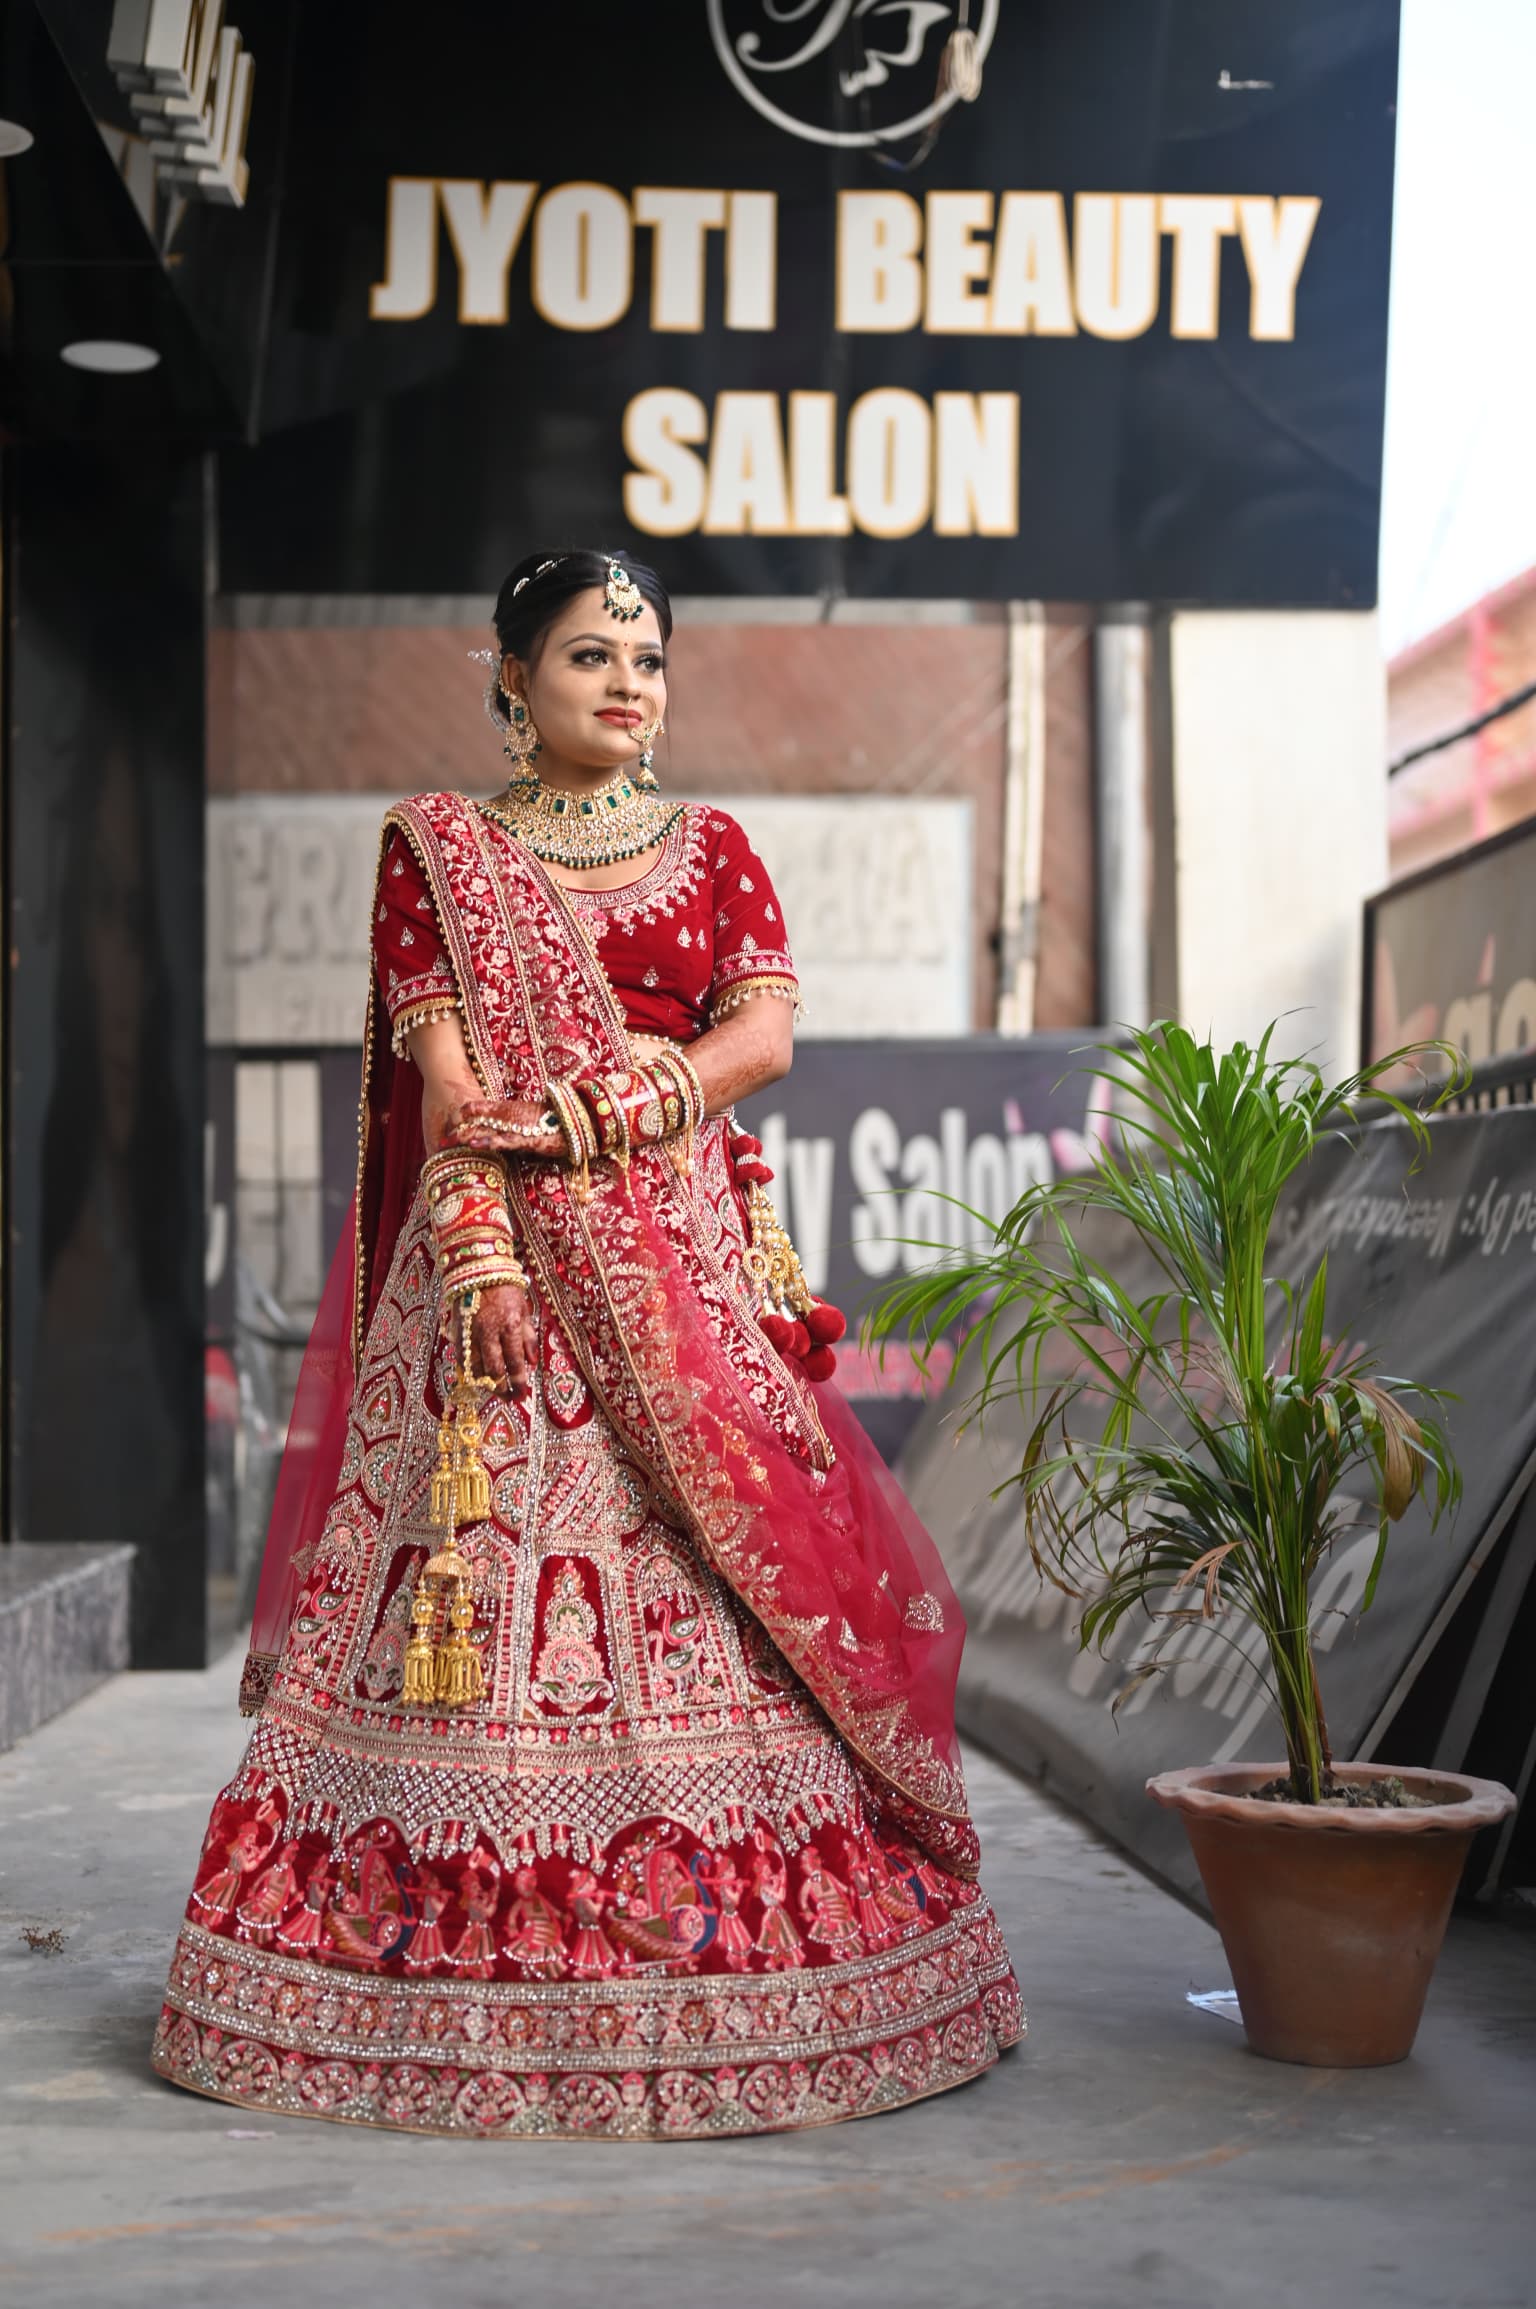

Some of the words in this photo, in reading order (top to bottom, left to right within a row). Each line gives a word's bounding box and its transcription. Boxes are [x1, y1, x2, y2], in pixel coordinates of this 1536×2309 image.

[371, 178, 777, 333] JYOTI
[834, 190, 1321, 341] BEAUTY
[623, 387, 1020, 540] SALON
